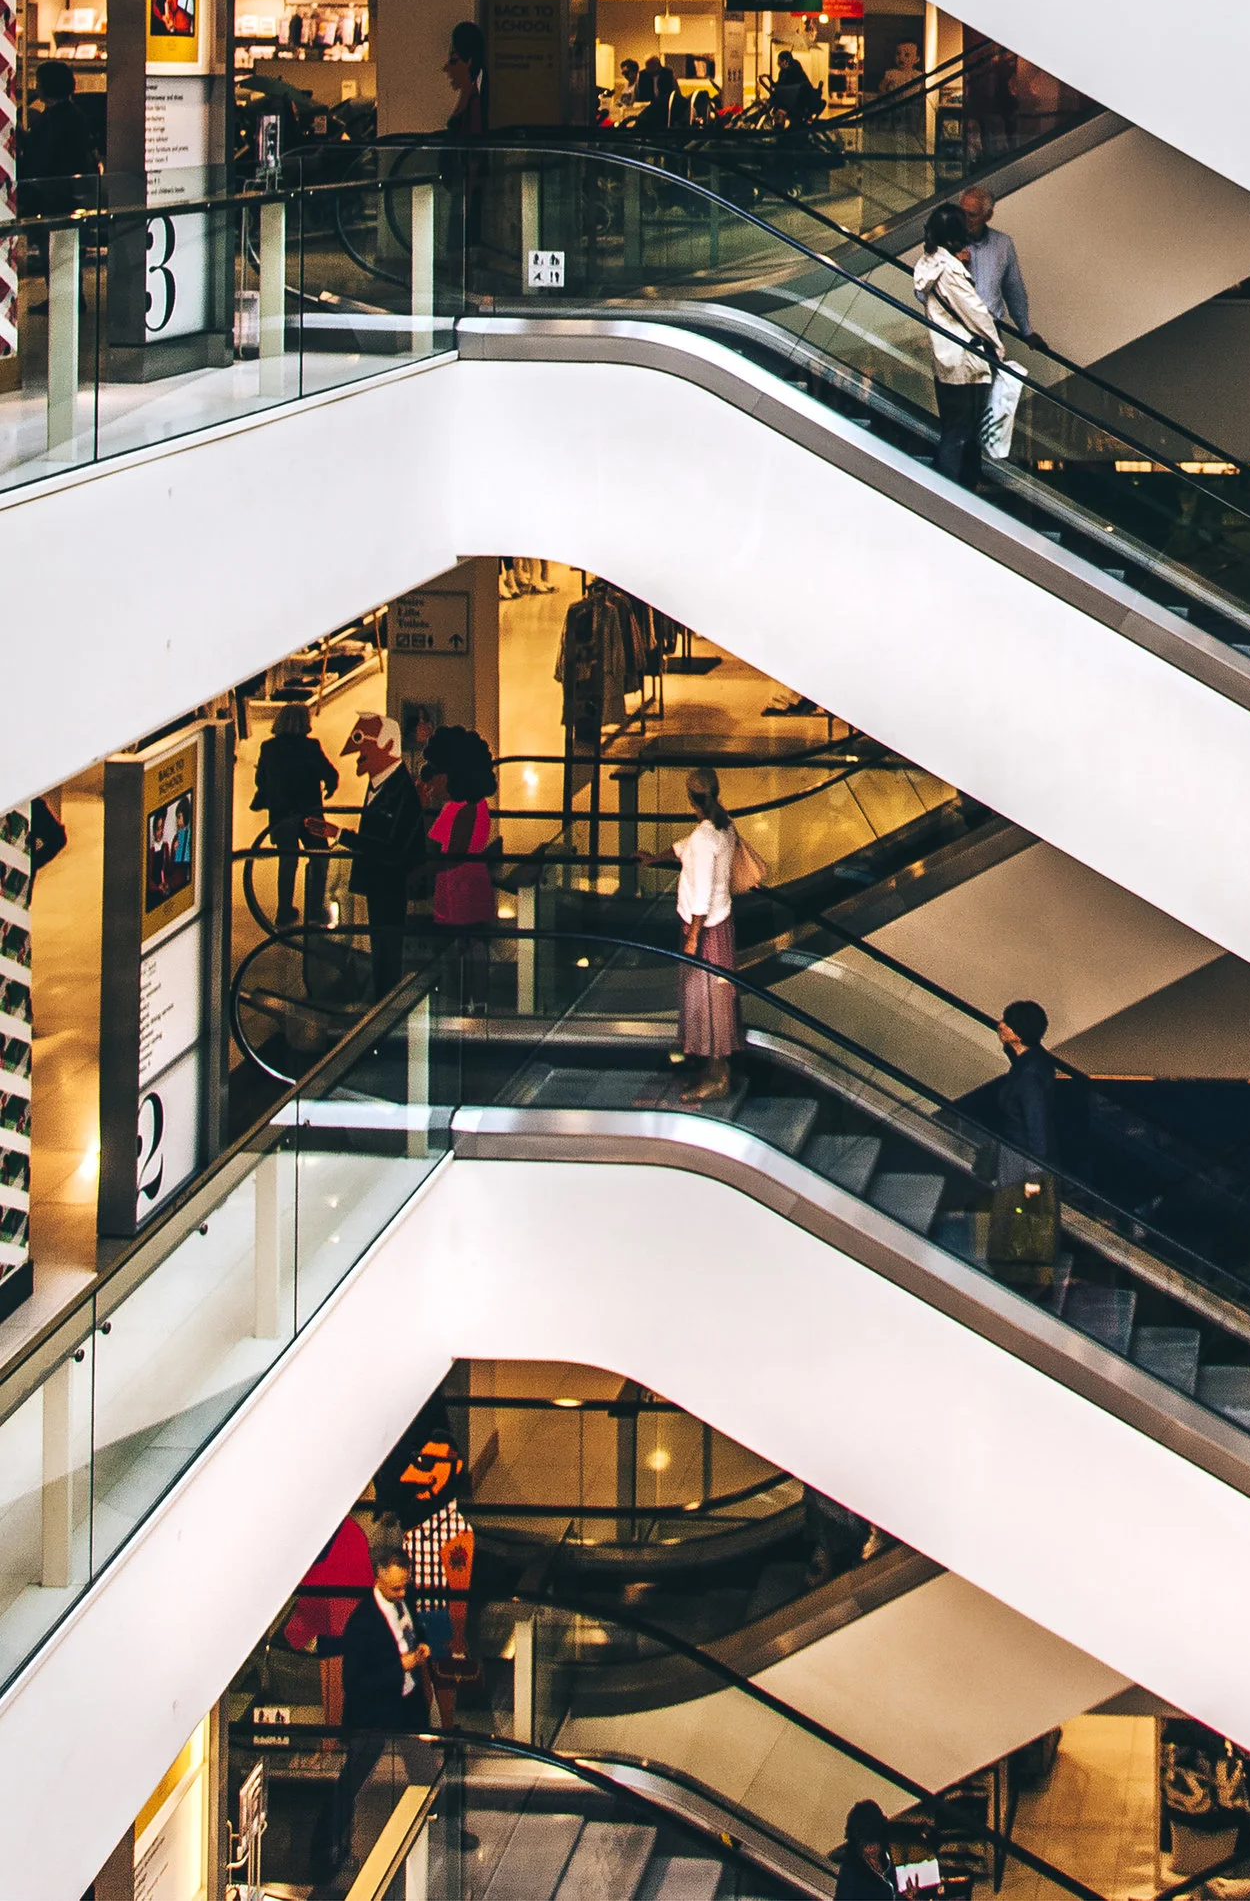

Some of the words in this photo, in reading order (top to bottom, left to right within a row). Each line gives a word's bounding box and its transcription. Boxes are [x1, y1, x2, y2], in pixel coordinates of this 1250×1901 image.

[494, 4, 531, 17] BACK
[534, 4, 554, 17] TO
[494, 19, 554, 32] SCHOOL
[146, 214, 176, 332] 3
[138, 1092, 164, 1201] 2
